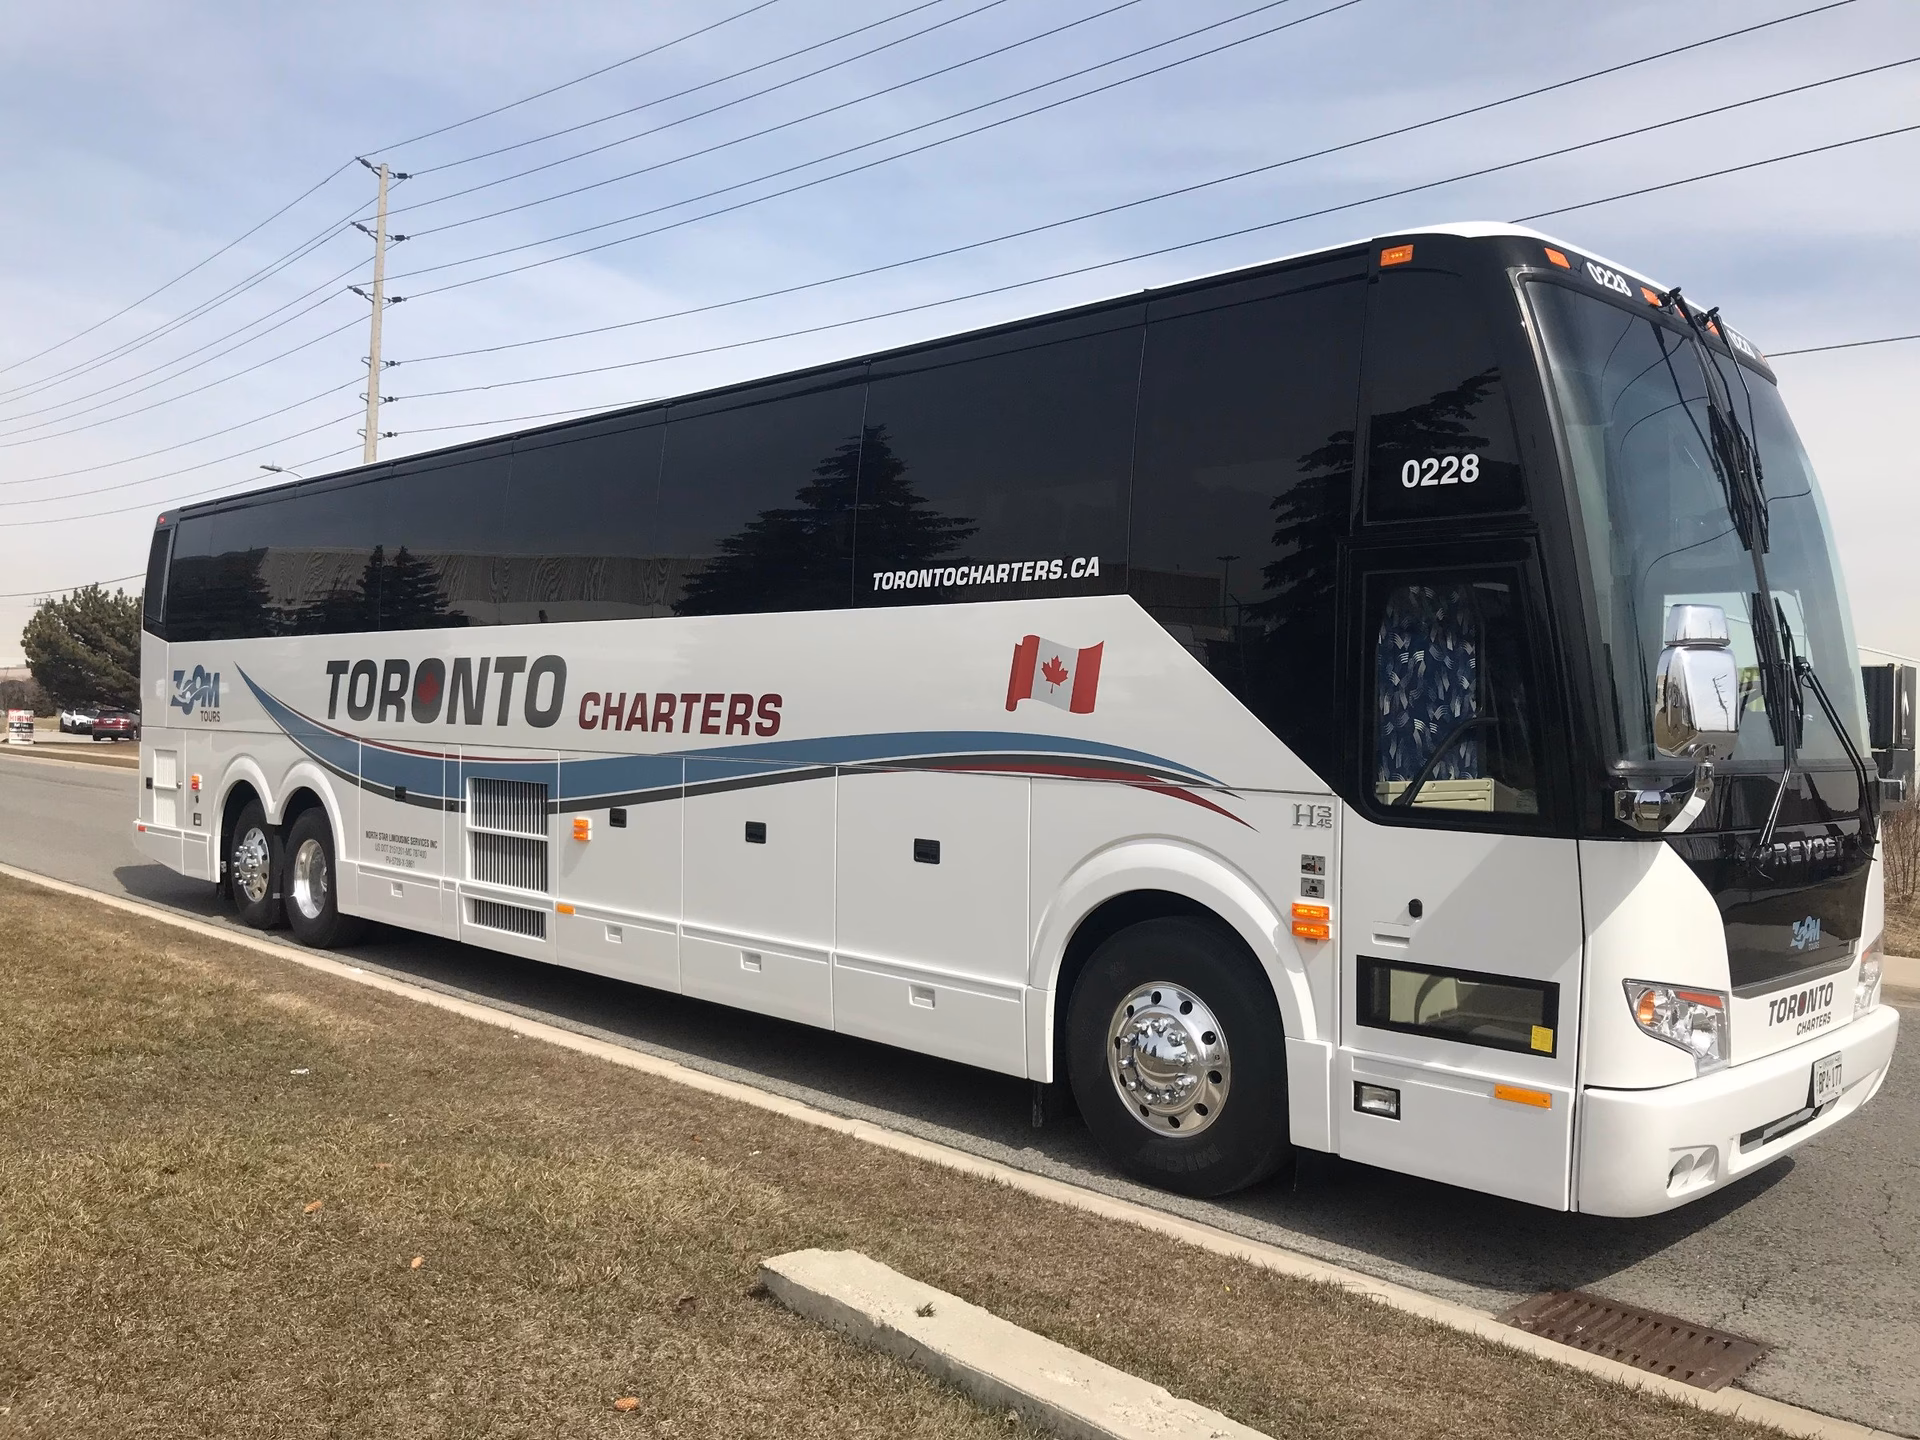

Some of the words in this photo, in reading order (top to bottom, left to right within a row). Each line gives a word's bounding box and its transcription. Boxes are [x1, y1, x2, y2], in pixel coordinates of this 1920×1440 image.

[1586, 261, 1633, 297] 0228
[1401, 453, 1480, 488] 0228
[872, 556, 1100, 591] TORONTOCHARTERS.CA
[325, 654, 568, 729] TORONTO
[578, 691, 783, 737] CHARTERS
[200, 710, 221, 722] TOURS
[365, 830, 378, 840] NORTH
[379, 832, 389, 841] STAR
[410, 836, 430, 848] SERVICES
[430, 840, 438, 849] INC
[1769, 982, 1834, 1027] TORONTO
[1796, 1011, 1832, 1036] CHARTERS
